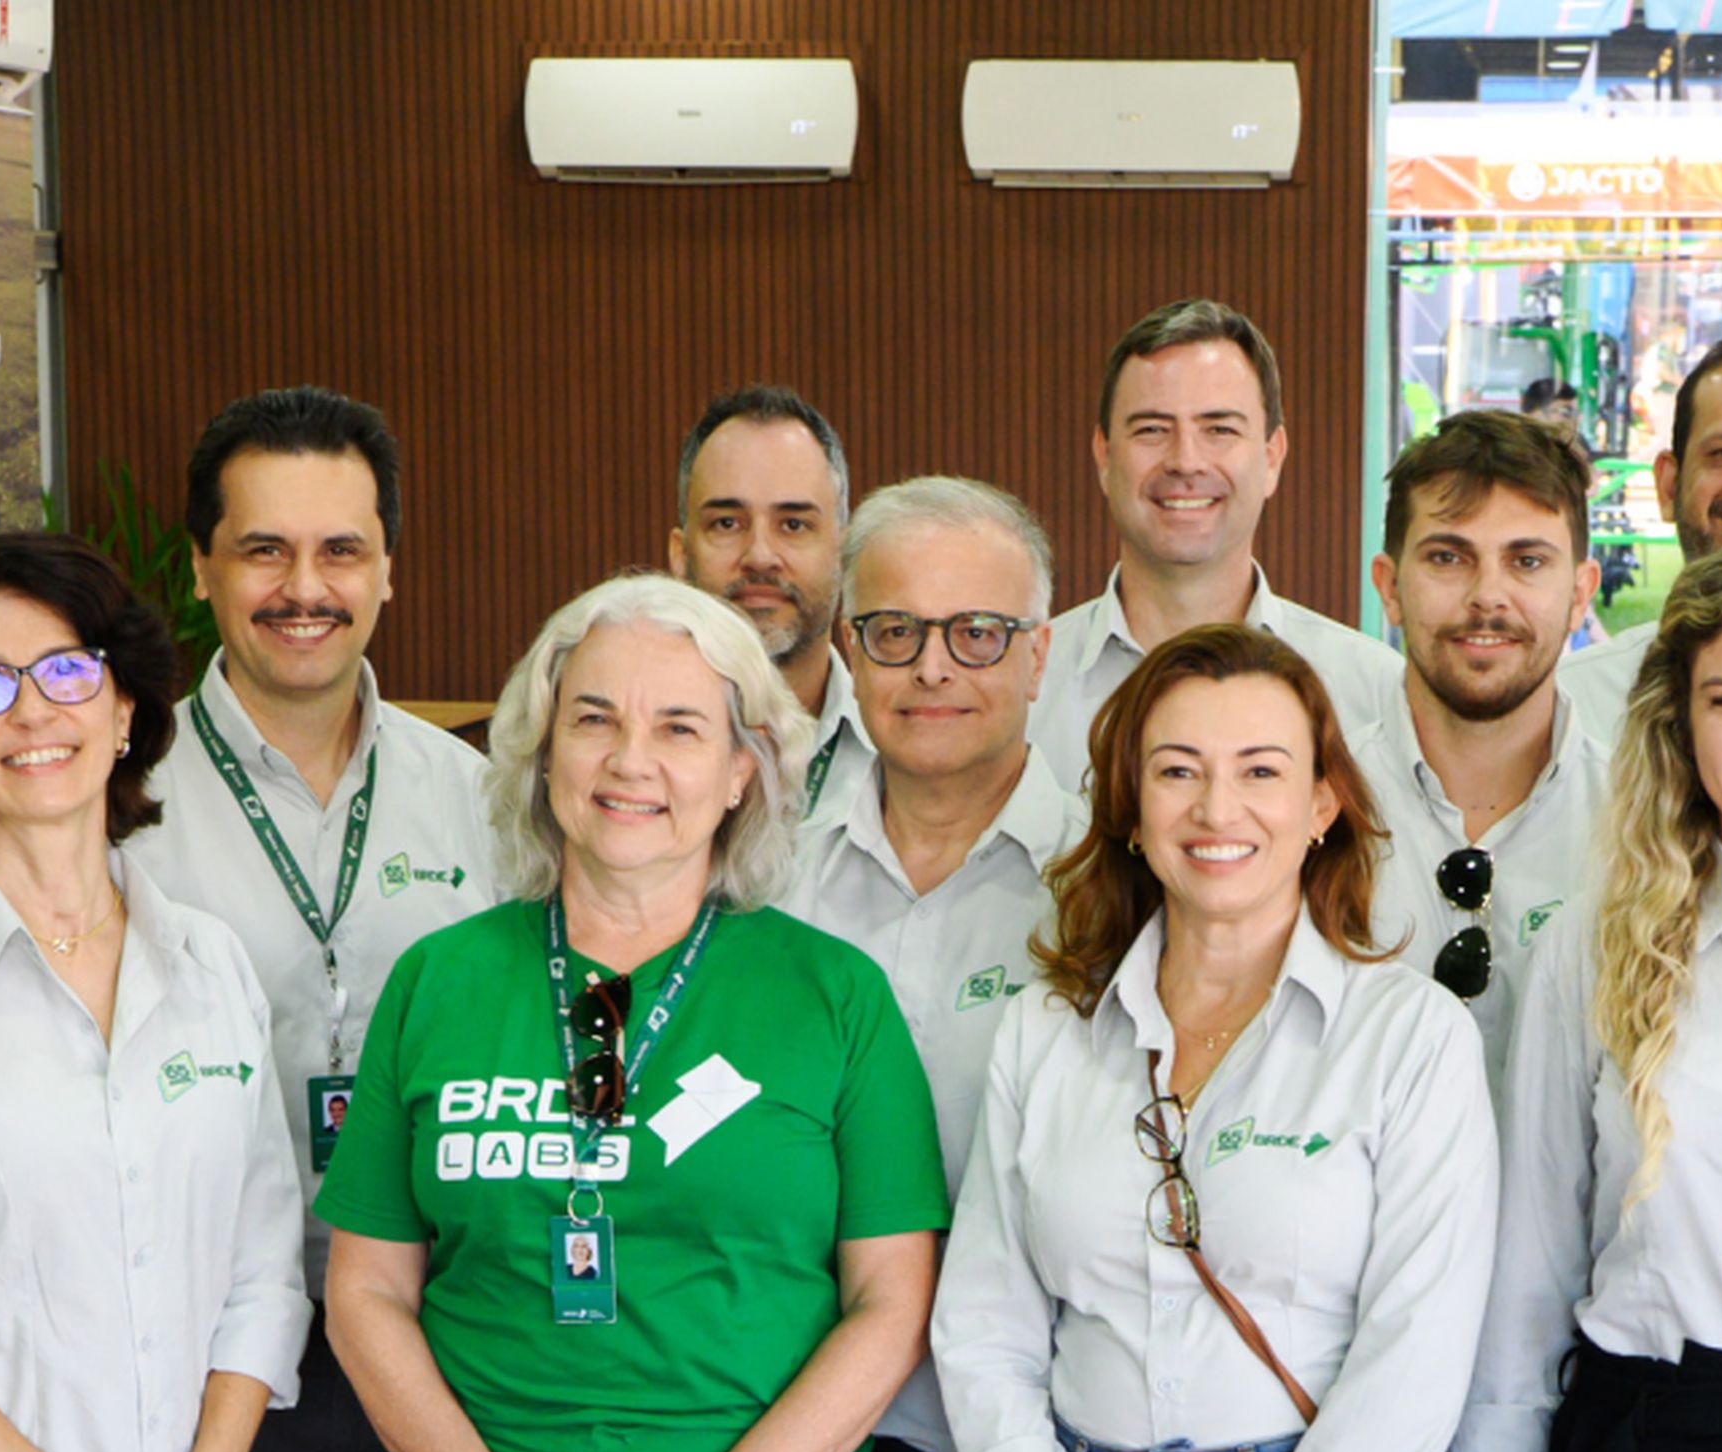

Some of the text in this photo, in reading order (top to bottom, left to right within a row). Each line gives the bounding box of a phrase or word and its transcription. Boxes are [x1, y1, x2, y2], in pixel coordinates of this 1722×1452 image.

[1548, 166, 1664, 195] JACTO
[438, 1075, 637, 1127] BRD
[441, 1136, 624, 1174] LABS
